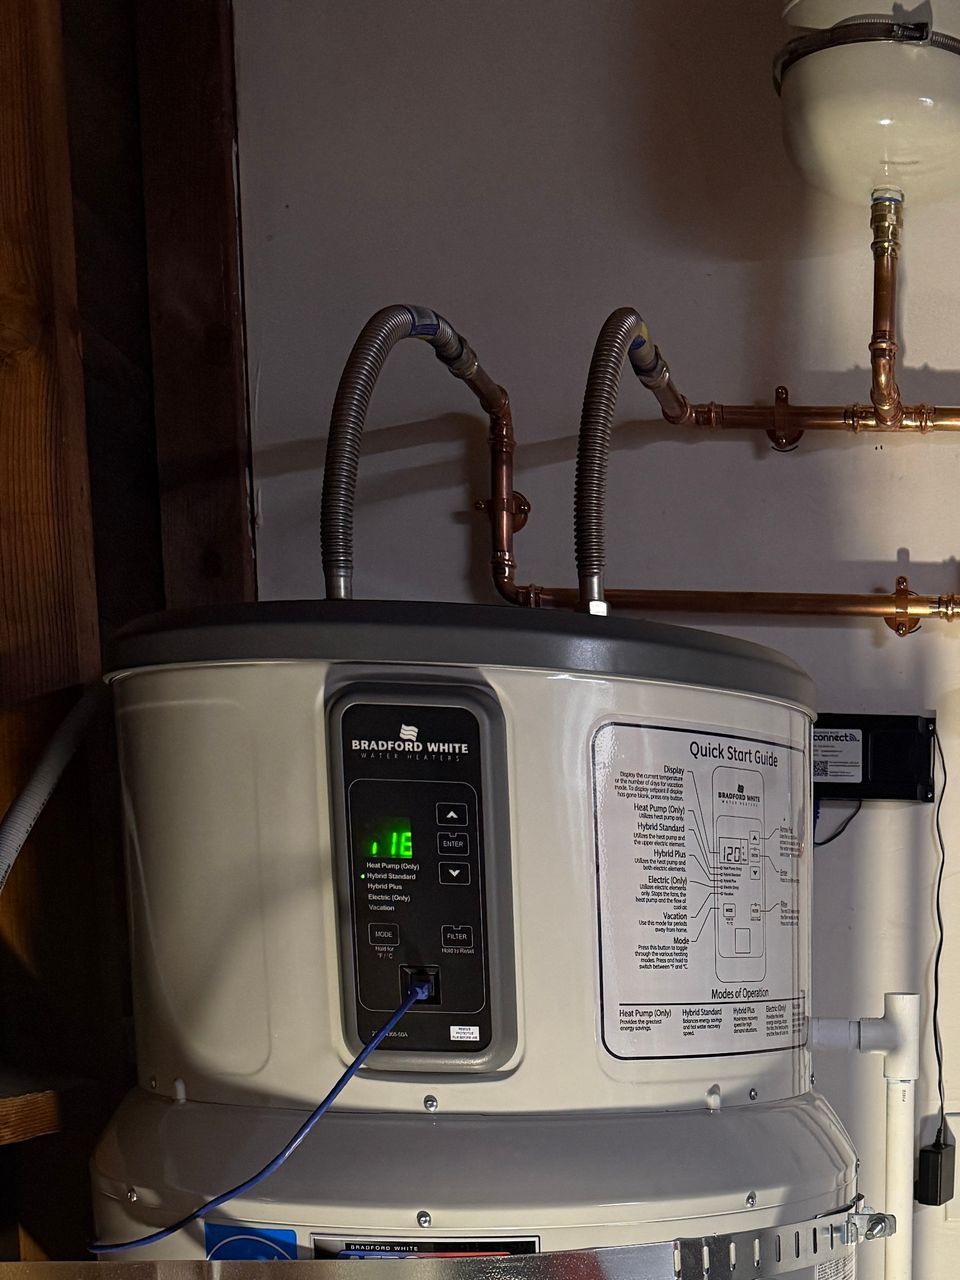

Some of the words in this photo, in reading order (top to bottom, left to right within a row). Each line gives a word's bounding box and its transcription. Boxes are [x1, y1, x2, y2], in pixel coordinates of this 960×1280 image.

[352, 740, 423, 752] BRADFORD
[427, 742, 469, 754] WHITE
[361, 752, 399, 760] WATER
[689, 741, 725, 761] Quick
[727, 745, 752, 764] Start
[754, 749, 778, 768] Guide
[663, 765, 685, 776] Display
[718, 791, 746, 801] BRADFORD
[747, 794, 760, 803] WHITE
[633, 803, 648, 812] Heat
[650, 804, 667, 814] Pump
[668, 805, 685, 815] (Only)
[637, 822, 658, 832] Hybrid
[659, 823, 685, 832] Standard
[653, 849, 673, 859] Hybrid
[675, 849, 686, 858] Plus
[722, 846, 741, 862] 120
[381, 862, 400, 870] Pump
[401, 863, 420, 871] (Only)
[367, 873, 387, 881] Hybrid
[648, 875, 670, 884] Electric
[671, 876, 687, 886] (Only)
[367, 883, 388, 891] Hybrid
[368, 904, 395, 912] Vacation
[663, 912, 688, 920] Vacation
[673, 937, 689, 945] Mode
[711, 988, 734, 1000] Modes
[735, 987, 742, 998] of
[742, 988, 769, 999] Operation
[619, 1009, 634, 1018] Heat
[635, 1009, 653, 1019] Pump
[654, 1009, 672, 1018] (Only)
[682, 1009, 700, 1018] Hybrid
[701, 1008, 722, 1016] Standard
[733, 1007, 746, 1015] Hybrid
